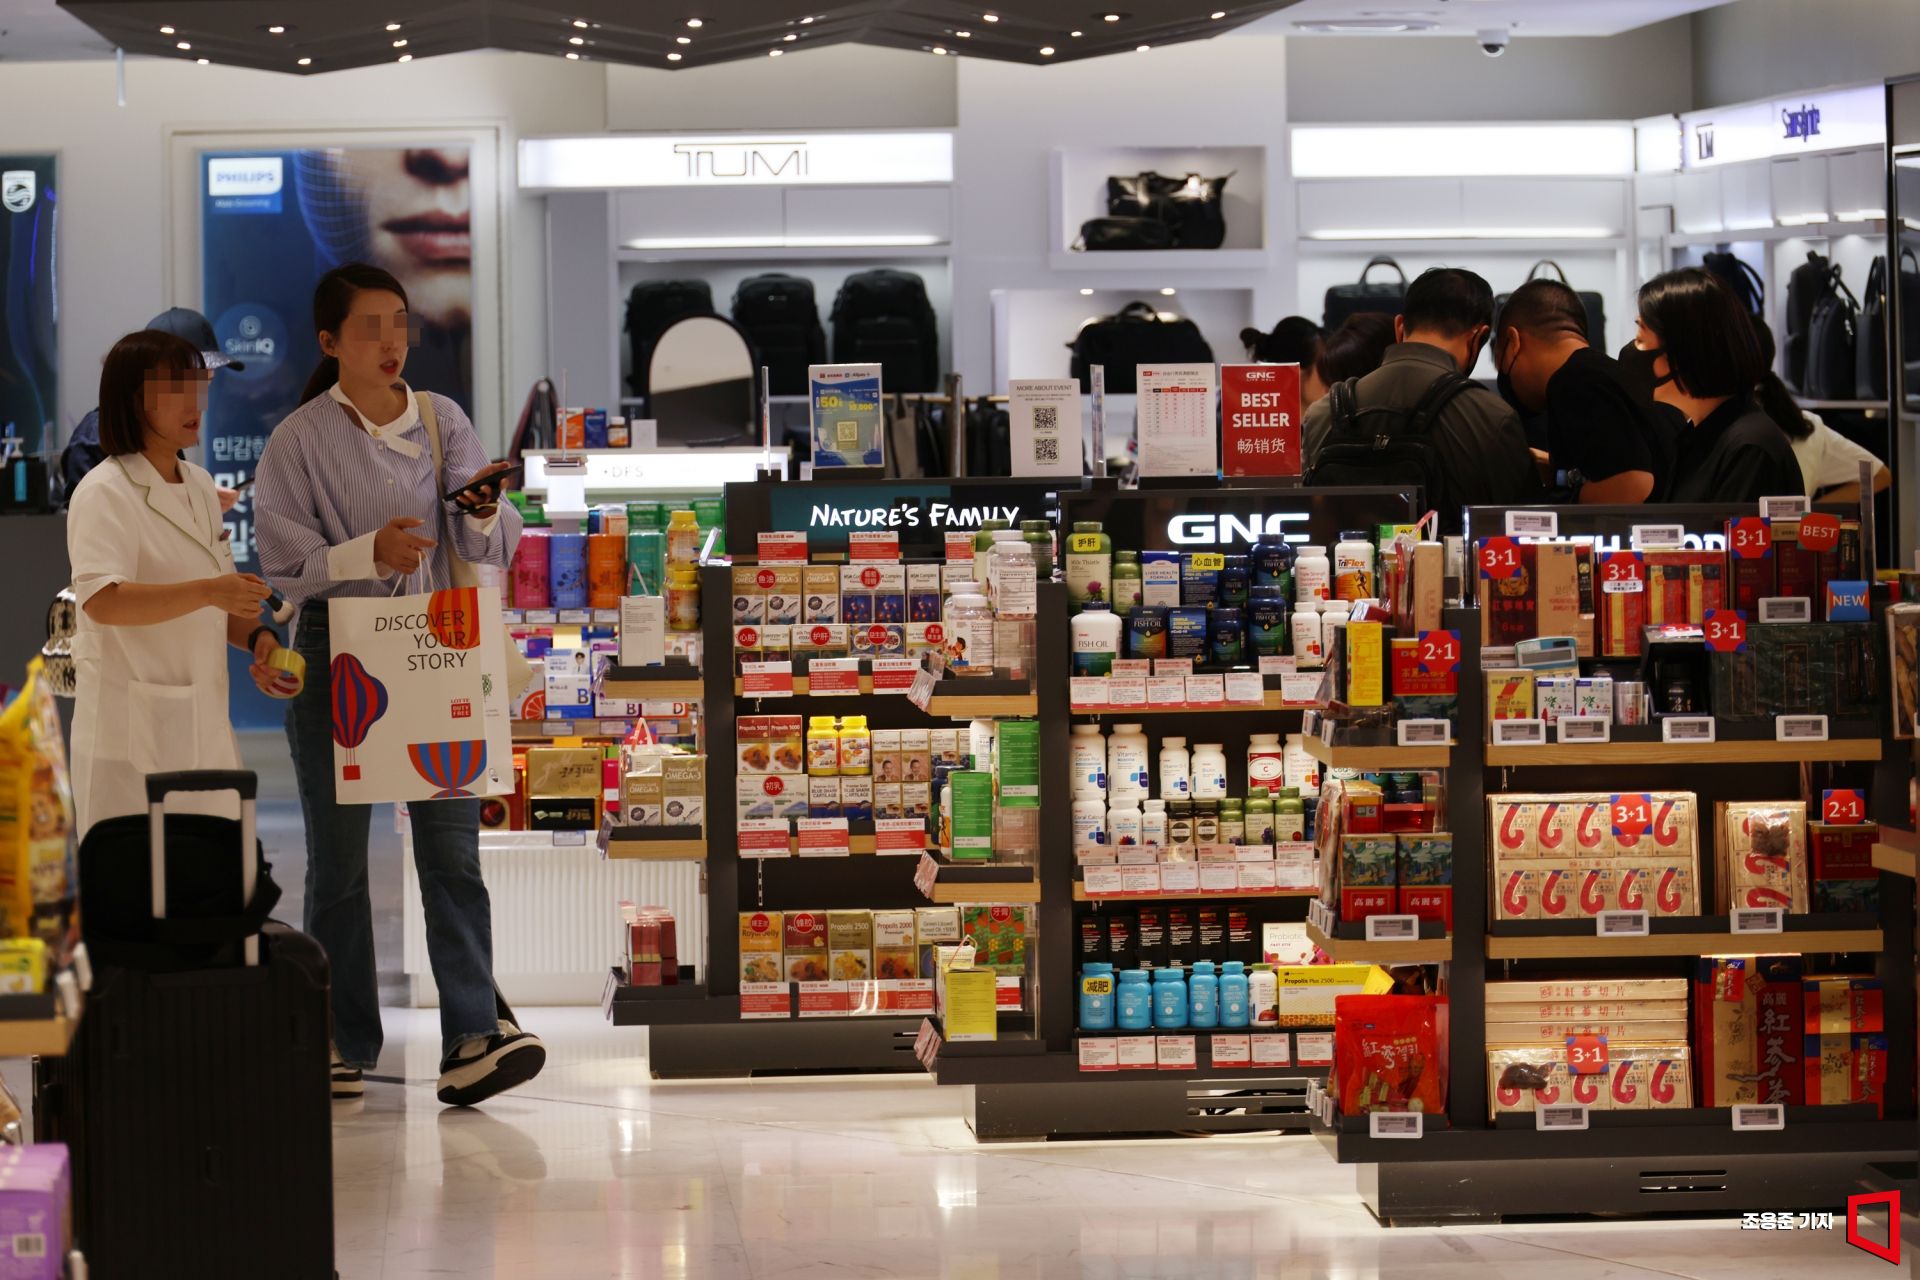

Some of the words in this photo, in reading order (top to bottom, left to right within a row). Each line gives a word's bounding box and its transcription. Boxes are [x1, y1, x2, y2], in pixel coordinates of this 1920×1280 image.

[674, 142, 808, 176] TUMI
[1246, 371, 1275, 379] GNC
[1241, 393, 1281, 408] BEST
[1232, 412, 1290, 428] SELLER
[1237, 438, 1286, 454] 畅销货
[1167, 513, 1310, 544] GNC
[1802, 525, 1837, 538] BEST
[1078, 537, 1096, 548] 护肝
[1736, 529, 1766, 546] 3+1
[1193, 557, 1222, 567] 心血管
[1338, 559, 1366, 567] TriFlex
[1485, 549, 1516, 567] 3+1
[1608, 563, 1638, 581] 3+1
[758, 576, 774, 584] 鱼油
[1832, 595, 1866, 607] NEW
[374, 610, 465, 632] DISCOVER
[813, 632, 829, 640] 护肝
[1710, 622, 1740, 639] 3+1
[413, 631, 466, 650] YOUR
[1078, 640, 1094, 648] FISH
[1095, 640, 1108, 648] OIL
[1424, 643, 1455, 660] 2+1
[407, 652, 468, 671] STORY
[577, 688, 589, 704] B
[626, 703, 637, 715] B
[673, 702, 684, 715] D
[765, 781, 781, 790] 初乳
[1616, 806, 1647, 823] 3+1
[1829, 802, 1860, 818] 2+1
[854, 922, 869, 930] 2500
[877, 922, 898, 930] Propolis
[1086, 980, 1109, 993] 减肥
[1572, 1047, 1604, 1063] 3+1
